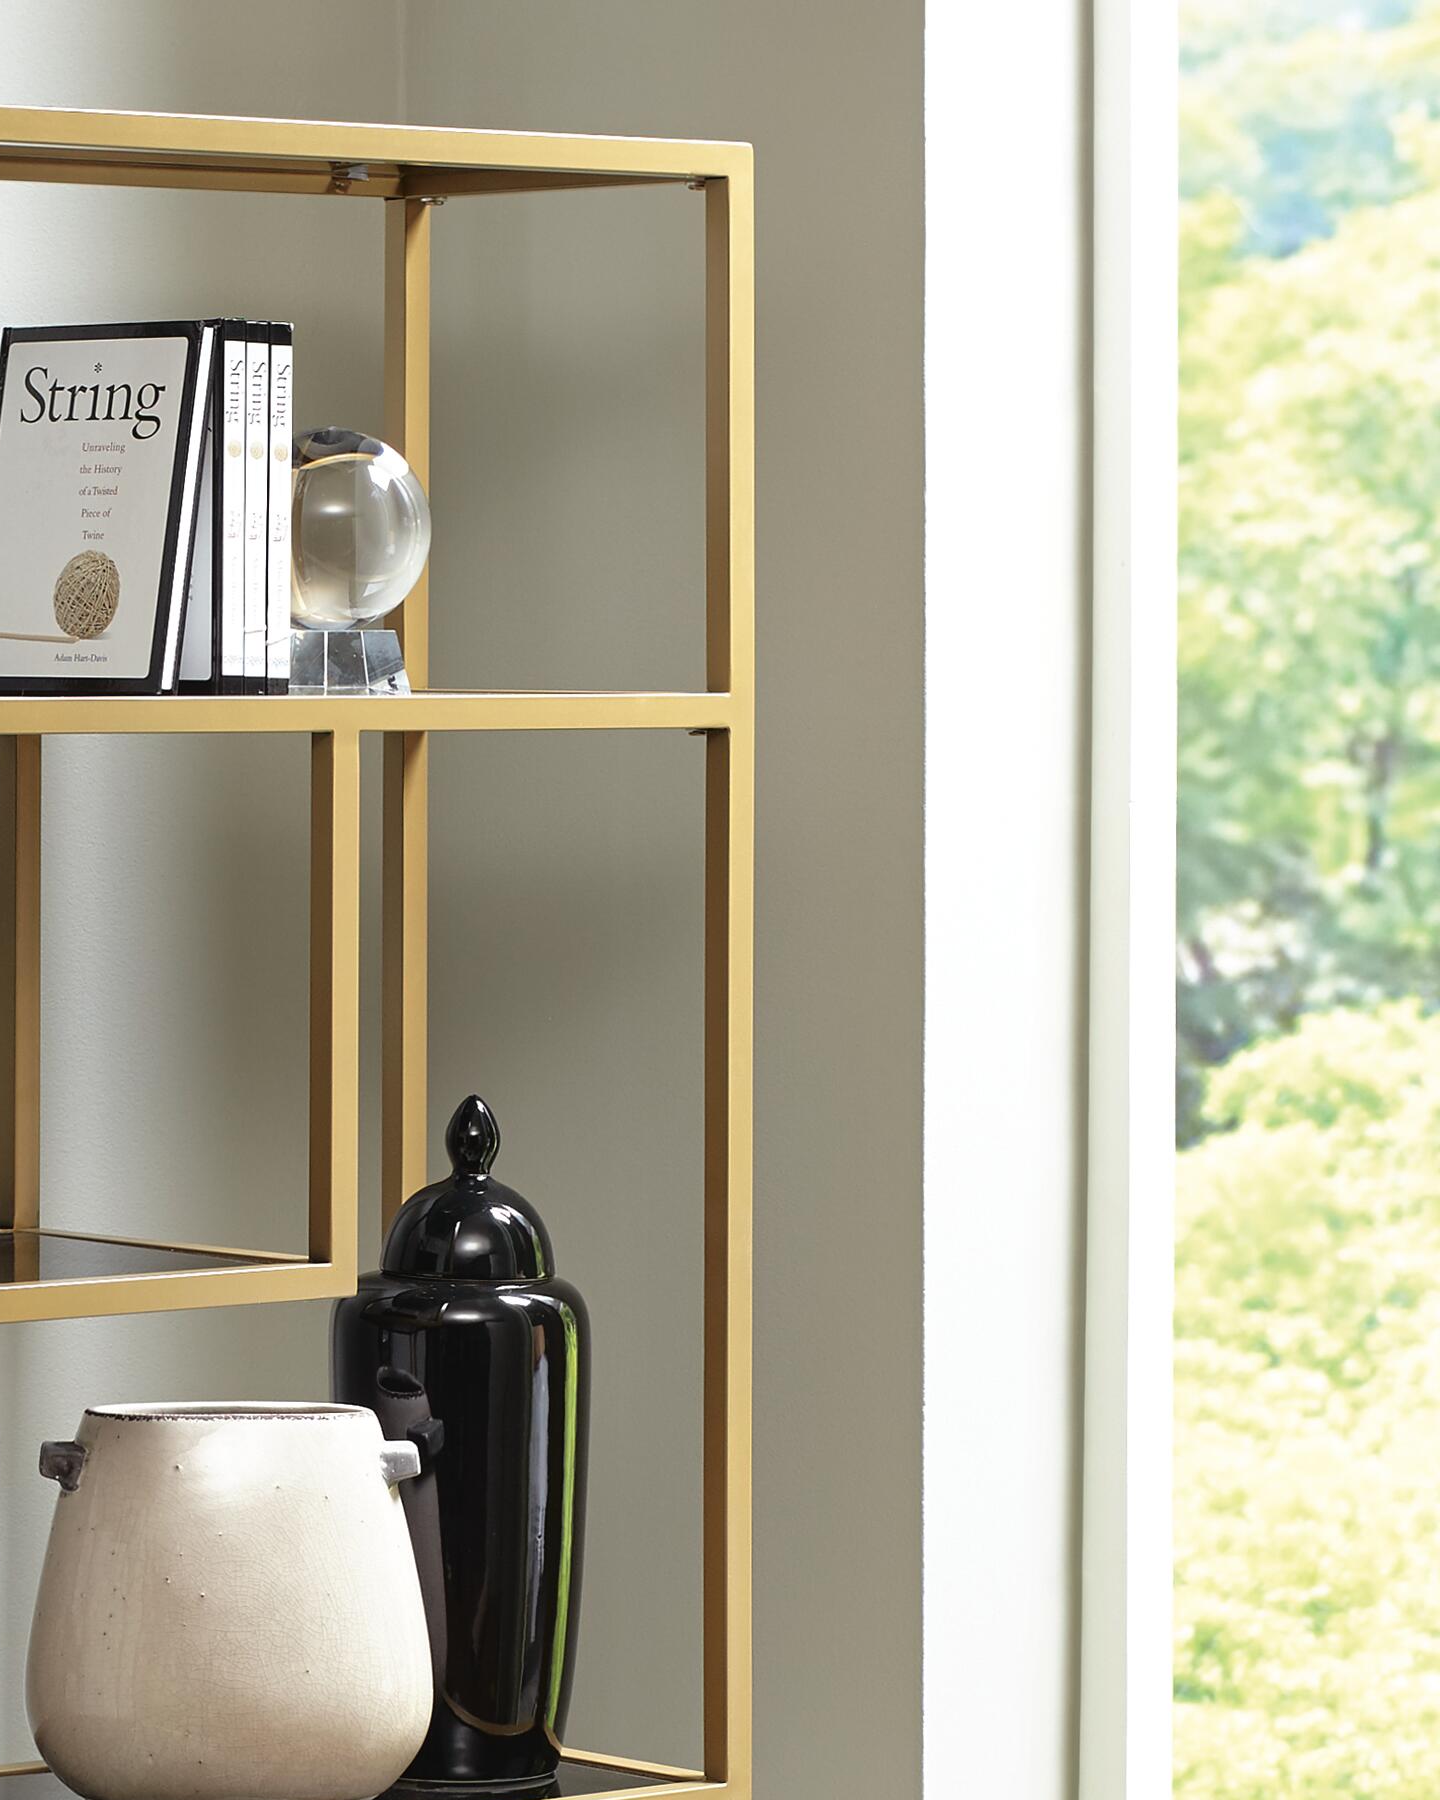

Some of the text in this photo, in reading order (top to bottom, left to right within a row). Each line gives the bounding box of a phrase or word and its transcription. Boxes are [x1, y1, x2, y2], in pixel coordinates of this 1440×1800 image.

[225, 359, 245, 423] String
[247, 361, 266, 425] String
[272, 363, 292, 428] String
[20, 362, 166, 440] String
[81, 442, 126, 455] Unraveling
[79, 464, 122, 476] the History
[78, 486, 87, 496] of
[92, 486, 118, 496] Twisted
[81, 507, 112, 518] Piece of
[82, 530, 105, 540] Twine
